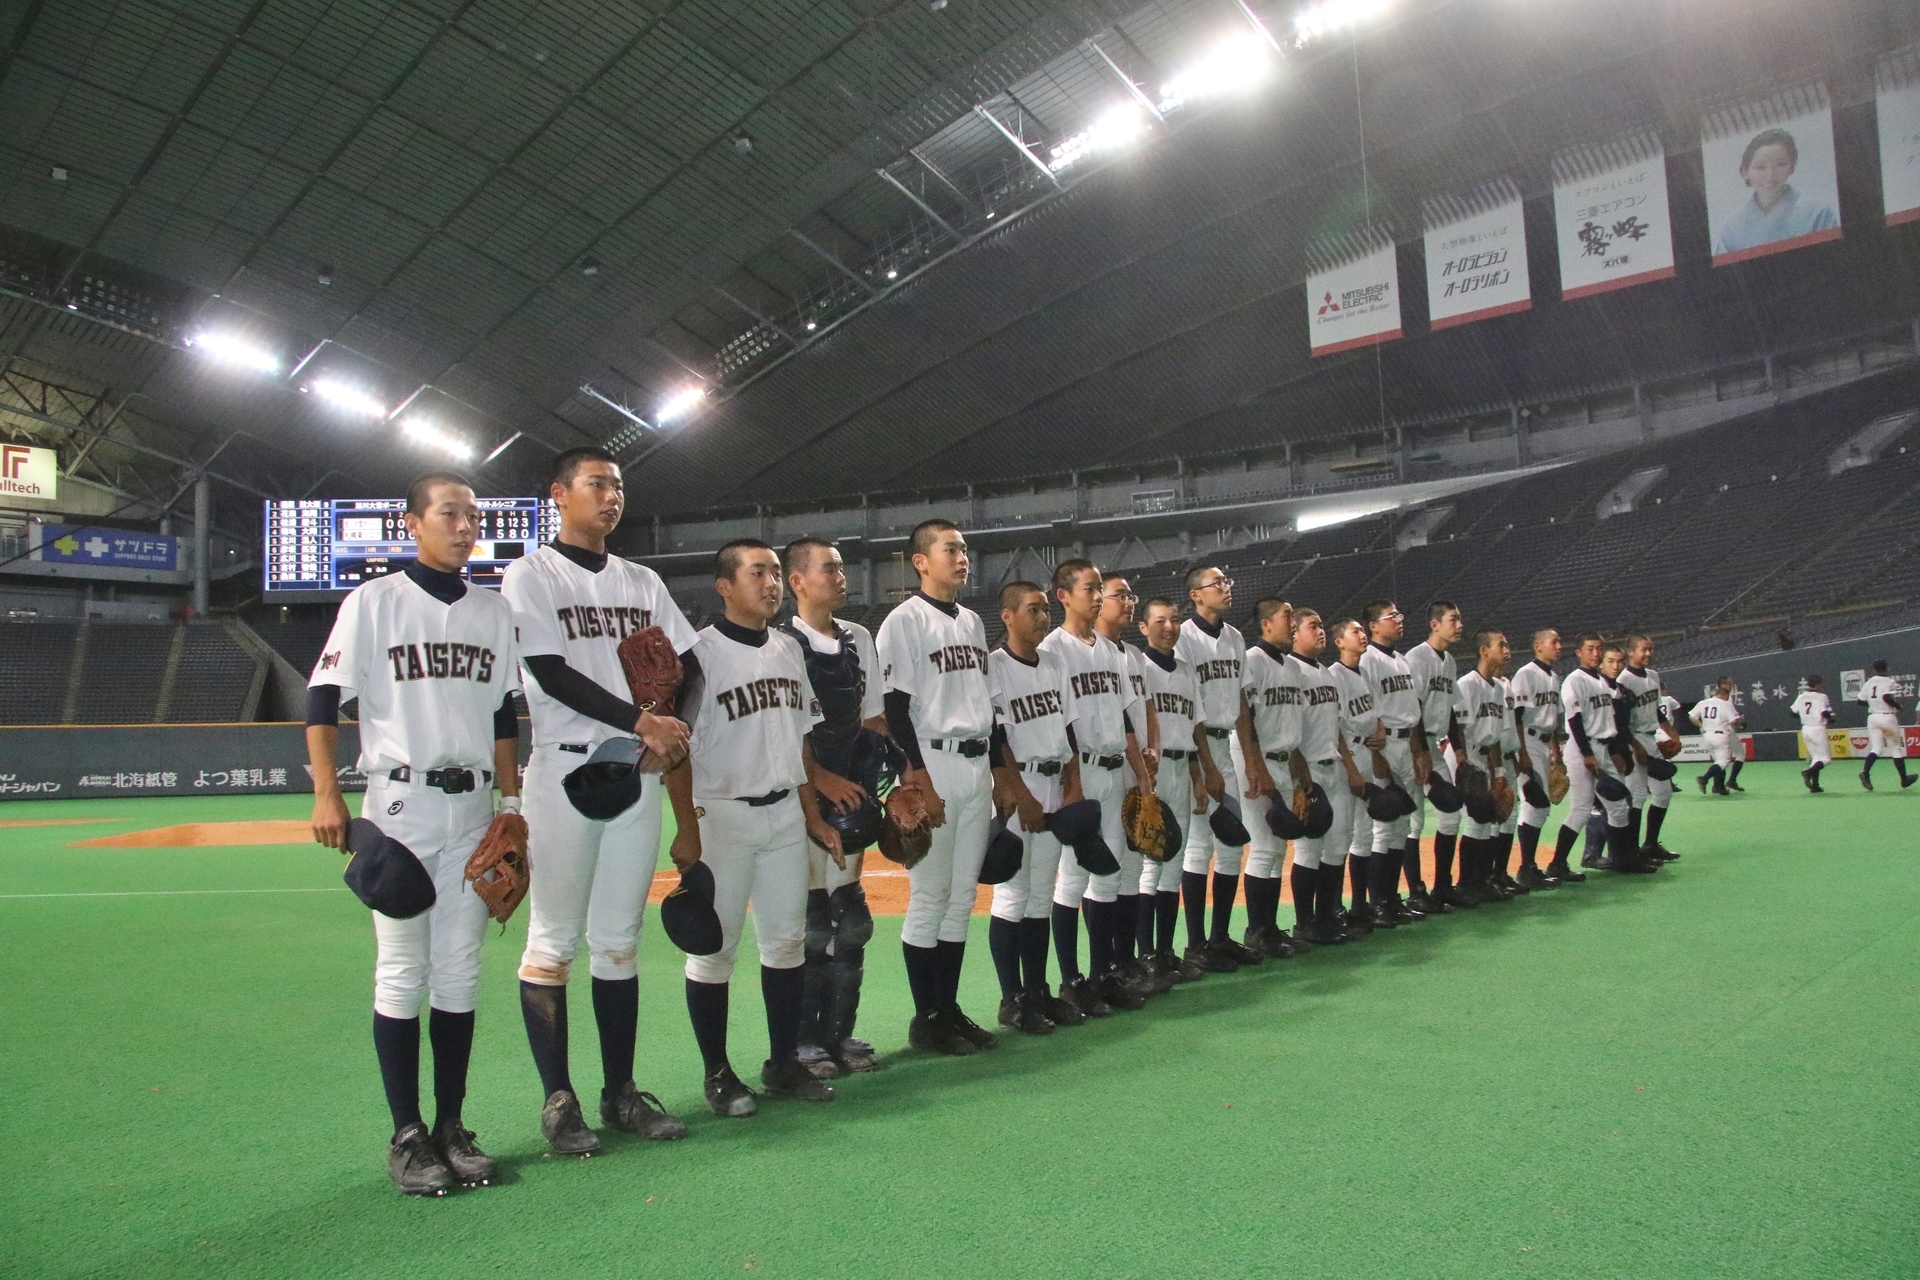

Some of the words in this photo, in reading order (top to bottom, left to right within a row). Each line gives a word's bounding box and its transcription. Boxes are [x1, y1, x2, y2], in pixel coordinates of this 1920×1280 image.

[1576, 195, 1647, 221] 三菱エアコン
[1442, 248, 1508, 277] オーロラビジョン
[1341, 282, 1390, 301] MITSUBISHI
[1443, 269, 1510, 297] オーロラリボン
[1342, 292, 1384, 310] ELECTRIC
[1317, 314, 1346, 325] Changes
[1346, 310, 1356, 319] for
[1369, 302, 1390, 314] Better
[386, 519, 394, 529] 0
[397, 519, 405, 529] 0
[480, 518, 487, 528] 4
[496, 518, 504, 528] 8
[508, 518, 519, 528] 12
[521, 518, 529, 528] 3
[387, 530, 393, 540] 1
[397, 530, 405, 540] 0
[481, 529, 486, 539] 1
[497, 529, 504, 539] 5
[509, 529, 517, 539] 8
[521, 529, 529, 539] 0
[114, 539, 168, 555] サツドラ
[1870, 685, 1877, 699] 1
[1704, 706, 1718, 719] 10
[1805, 701, 1812, 715] 7
[112, 772, 178, 788] 北海紙管
[193, 767, 288, 788] よつ葉乳業
